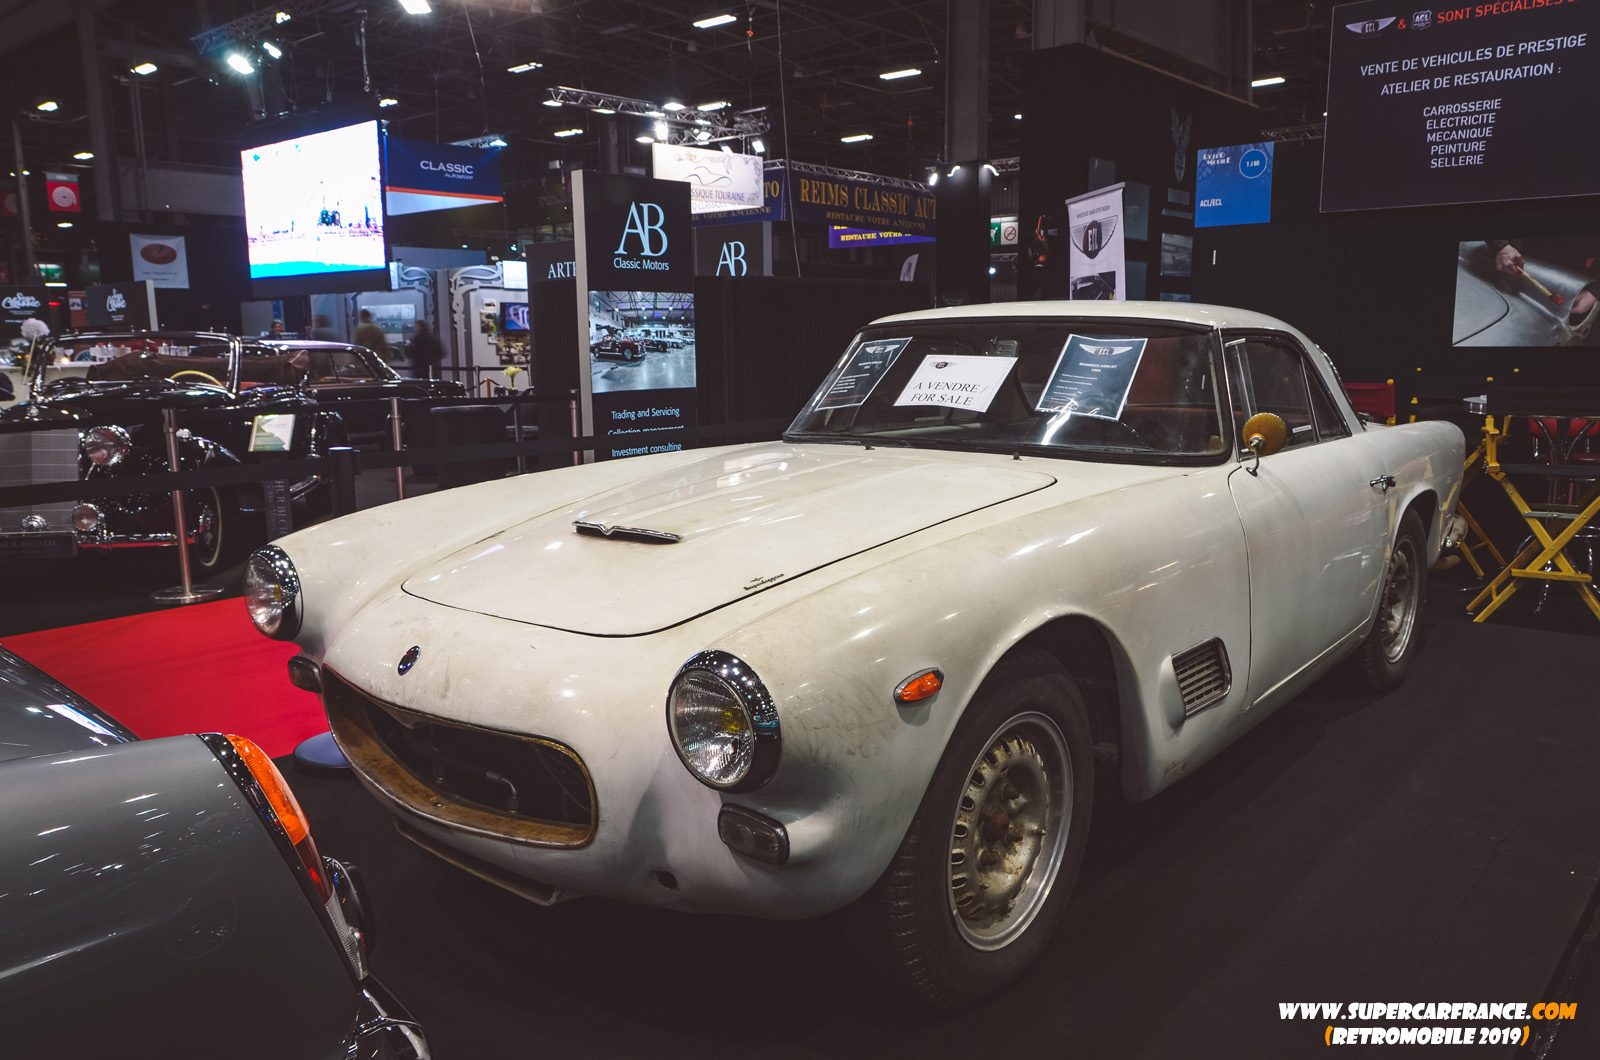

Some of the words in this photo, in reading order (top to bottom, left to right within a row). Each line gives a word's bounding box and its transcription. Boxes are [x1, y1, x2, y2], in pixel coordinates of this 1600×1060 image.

[1397, 19, 1406, 29] &
[1415, 13, 1429, 23] ACL
[1437, 7, 1472, 24] SONT
[1360, 60, 1399, 76] VENTE
[1402, 58, 1418, 71] DE
[1421, 48, 1492, 69] VEHICULES
[1496, 44, 1514, 58] DE
[1518, 33, 1587, 55] PRESTIGE
[1381, 79, 1430, 96] ATELIER
[1434, 75, 1450, 89] DE
[1454, 62, 1554, 87] RESTAURATION
[1423, 98, 1502, 117] CARROSSERIE
[1426, 112, 1497, 130] ELECTRICITE
[1426, 126, 1494, 143] MECANIQUE
[1431, 140, 1487, 155] PEINTURE
[420, 160, 474, 175] CLASSIC
[1430, 154, 1485, 168] SELLERIE
[715, 190, 745, 202] TOURAINE
[800, 178, 849, 208] REIMS
[854, 186, 910, 215] CLASSIC
[1200, 198, 1222, 208] ACL/ECL
[703, 211, 728, 220] VOTRE
[826, 211, 865, 223] RESTAURE
[867, 215, 891, 226] VOTRE
[893, 219, 926, 231] ANCIENNE
[614, 201, 669, 257] AB
[840, 232, 877, 242] RESTAURE
[613, 257, 641, 269] Classic
[642, 259, 670, 271] Motors
[715, 241, 748, 277] AB
[913, 382, 922, 390] A
[927, 382, 980, 393] VENDRE
[910, 393, 936, 403] FOR
[937, 394, 974, 406] SALE
[611, 409, 636, 421] Trading
[637, 407, 650, 418] and
[651, 406, 680, 418] Servicing
[611, 445, 649, 457] Investment
[649, 442, 682, 454] consulting
